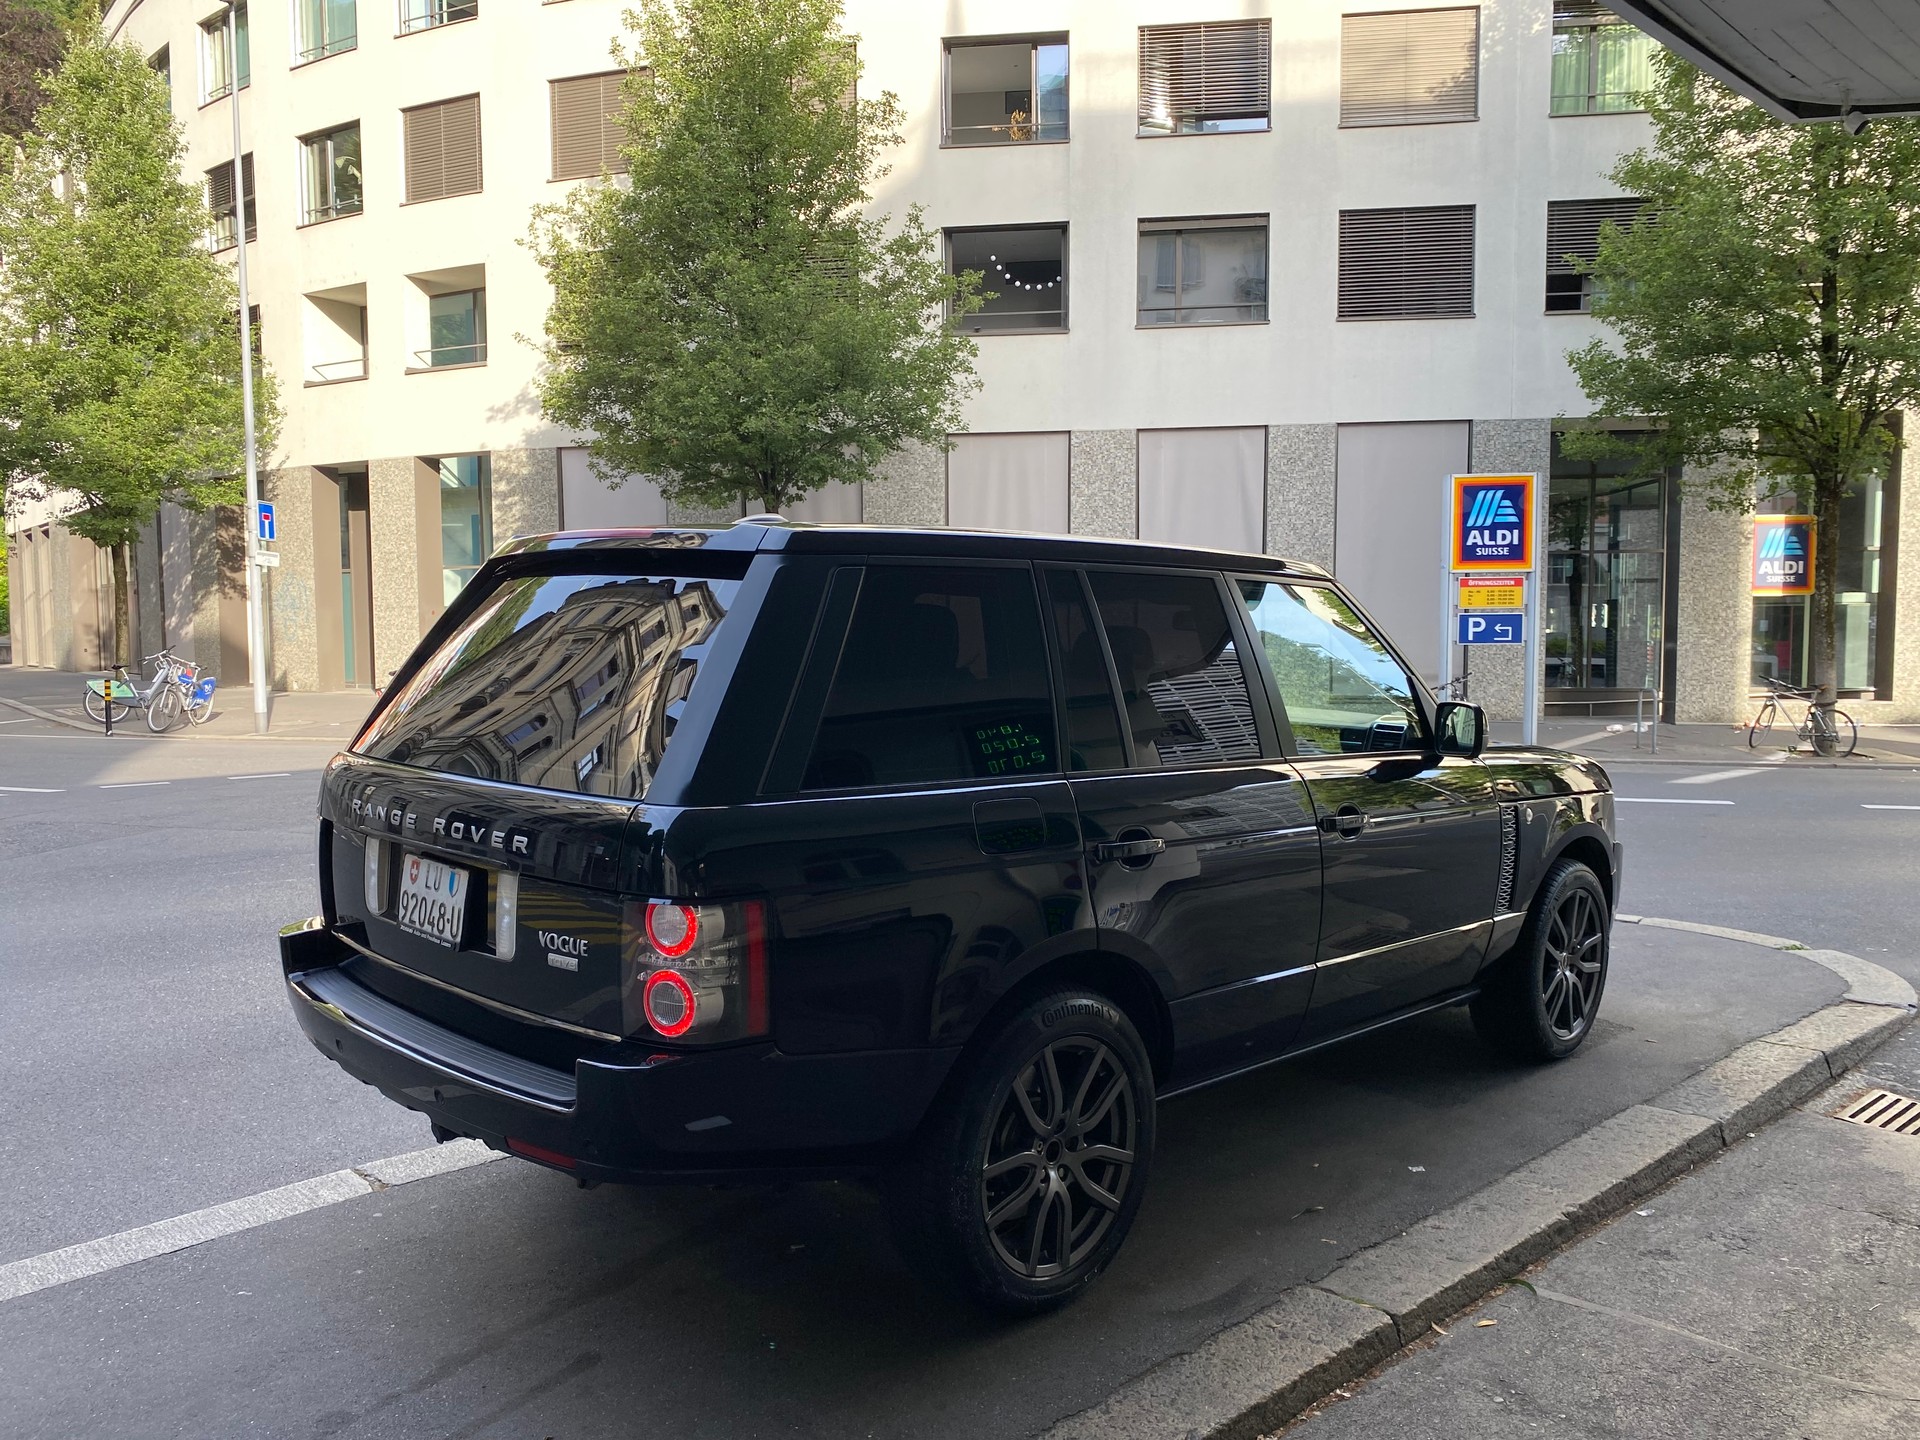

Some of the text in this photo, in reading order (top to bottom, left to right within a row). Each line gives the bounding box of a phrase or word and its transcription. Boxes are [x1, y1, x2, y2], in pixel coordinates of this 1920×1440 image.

[1466, 529, 1519, 546] ALDI
[1475, 547, 1510, 556] SUISSE
[1758, 560, 1805, 575] ALDI
[1766, 575, 1796, 583] SUISSE
[1468, 617, 1486, 641] P
[351, 798, 528, 855] RANGE ROVER
[424, 863, 443, 893] LU
[538, 930, 589, 957] VOGUE
[1041, 1001, 1104, 1027] Continental
